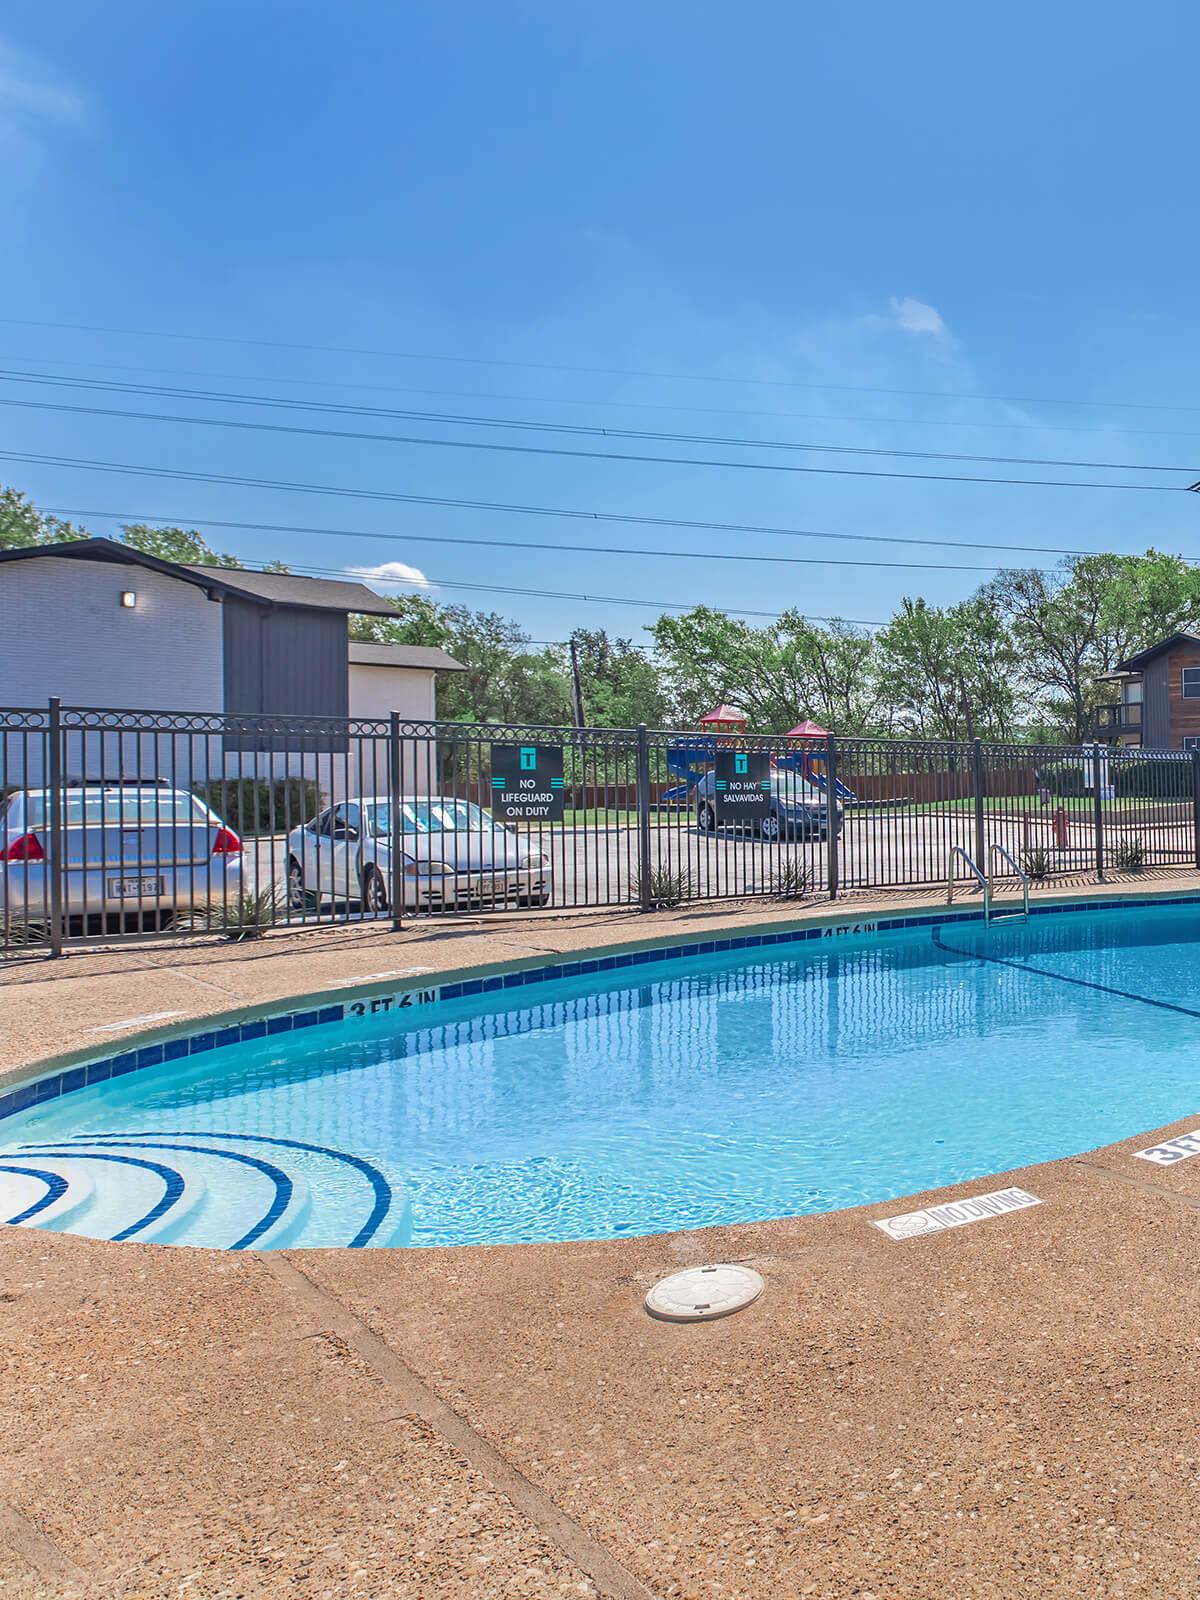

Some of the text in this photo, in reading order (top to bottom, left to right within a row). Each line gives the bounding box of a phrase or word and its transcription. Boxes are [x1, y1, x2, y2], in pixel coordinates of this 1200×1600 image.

[519, 779, 536, 788] NO
[729, 782, 757, 790] NO HAY
[501, 793, 554, 802] LIFEGUARD
[723, 794, 764, 802] SALVAVIDAS
[506, 807, 549, 816] ON DUTY
[350, 1002, 366, 1017] 3
[371, 997, 394, 1014] FT
[418, 990, 436, 1005] IN
[1143, 1147, 1184, 1161] 3
[931, 1190, 1037, 1225] NO DIVING
